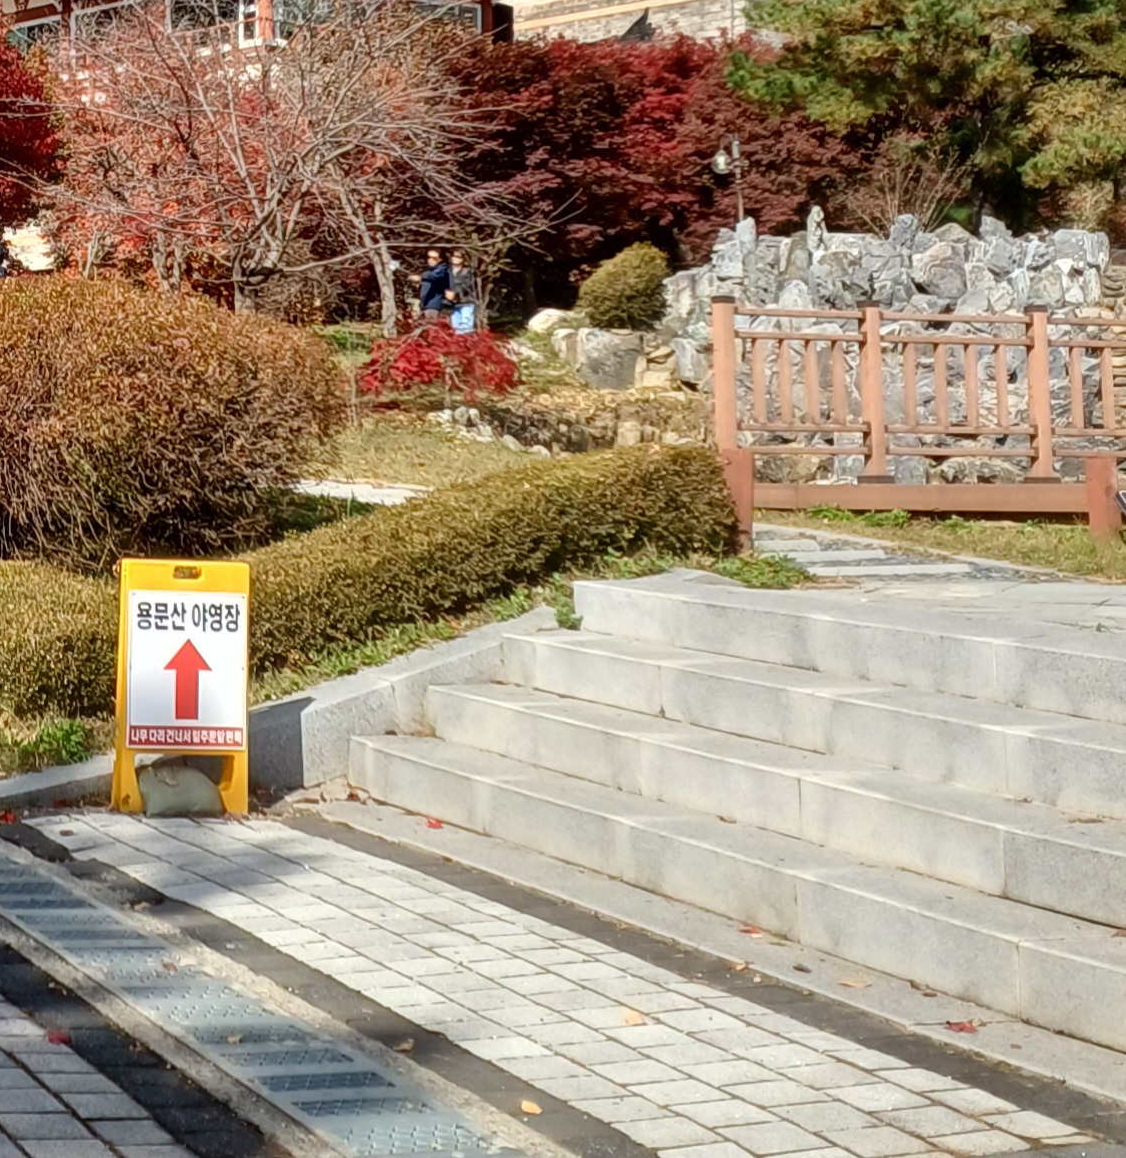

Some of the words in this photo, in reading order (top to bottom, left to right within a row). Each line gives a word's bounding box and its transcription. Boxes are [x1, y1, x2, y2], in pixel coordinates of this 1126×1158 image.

[136, 601, 187, 631] 용문산
[191, 602, 240, 632] 야영장
[166, 729, 191, 743] 건너서
